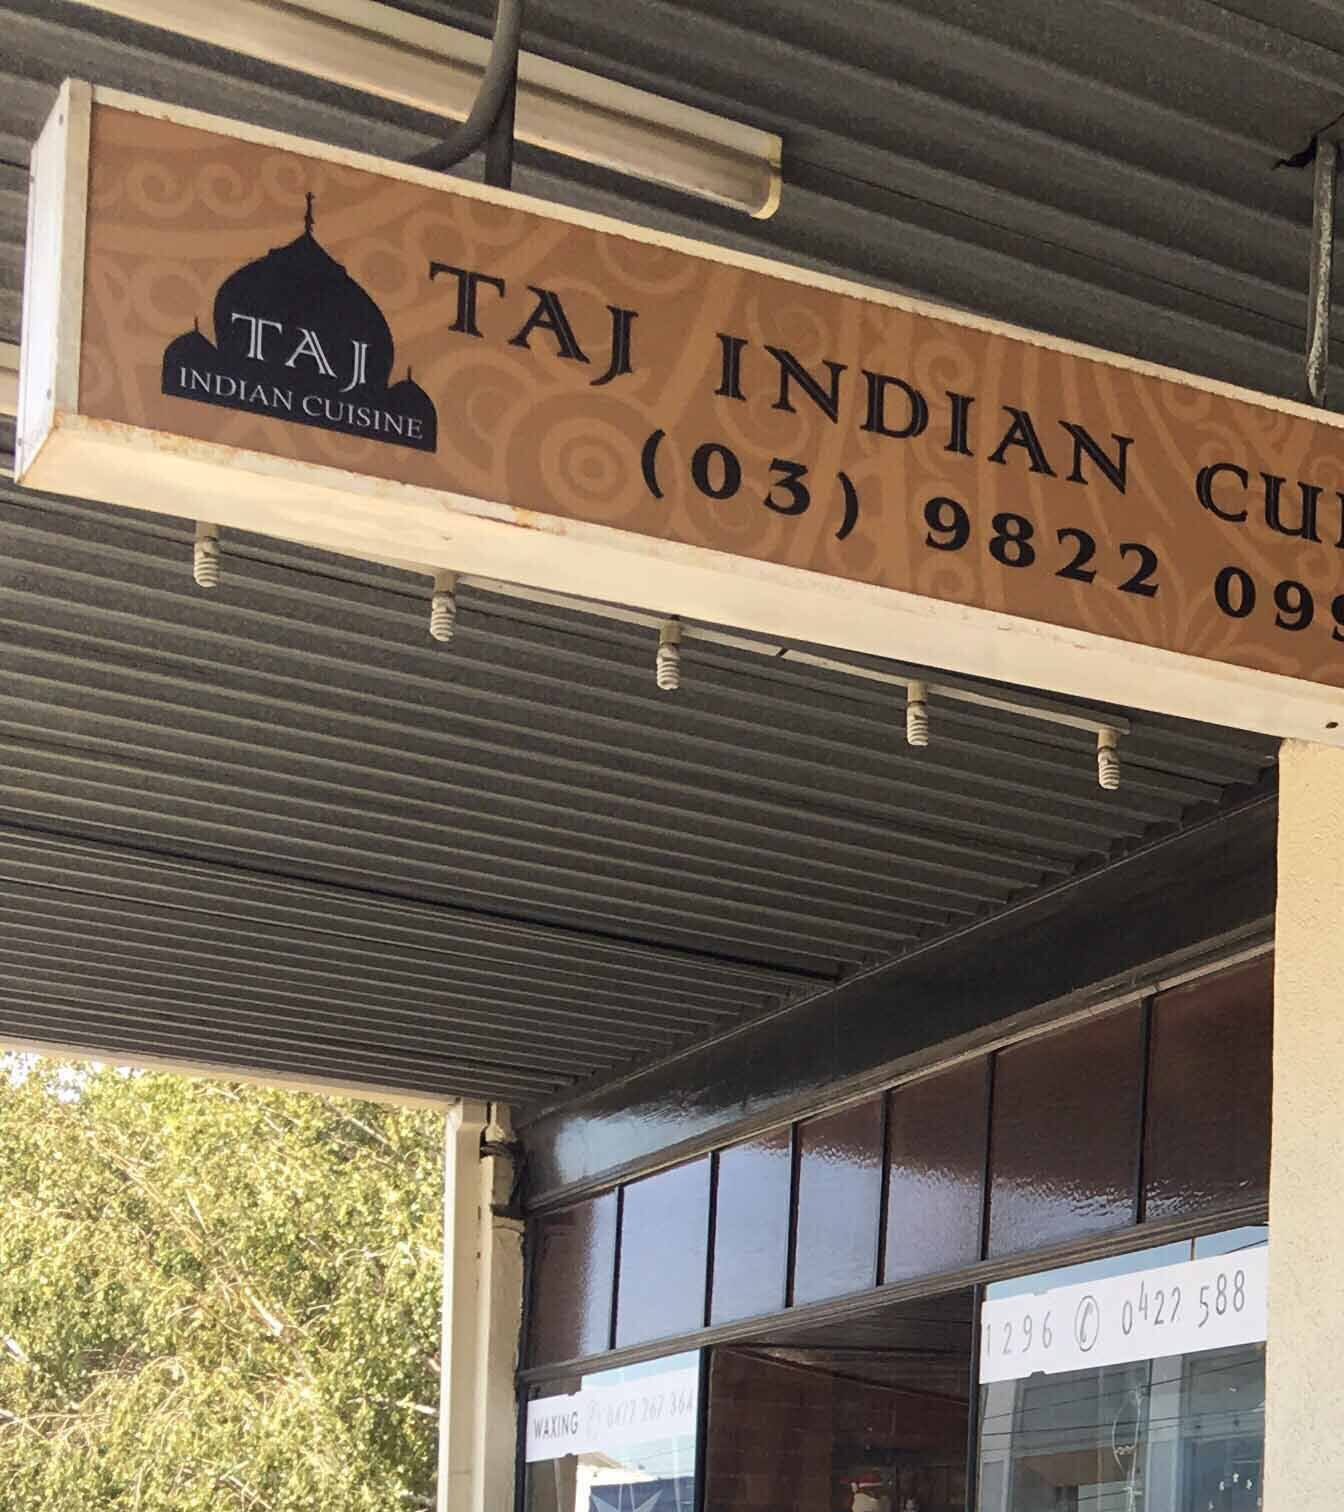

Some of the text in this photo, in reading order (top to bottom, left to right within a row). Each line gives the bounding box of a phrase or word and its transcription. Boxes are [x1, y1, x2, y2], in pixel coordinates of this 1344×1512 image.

[231, 312, 370, 393] TAJ
[428, 260, 640, 387] TAJ
[713, 332, 1135, 496] INDIAN
[179, 366, 424, 441] INDIAN CUISINE
[641, 429, 860, 542] (03)
[923, 495, 1160, 599] 9822
[1197, 1268, 1246, 1329] 588
[533, 1411, 579, 1440] WAXING
